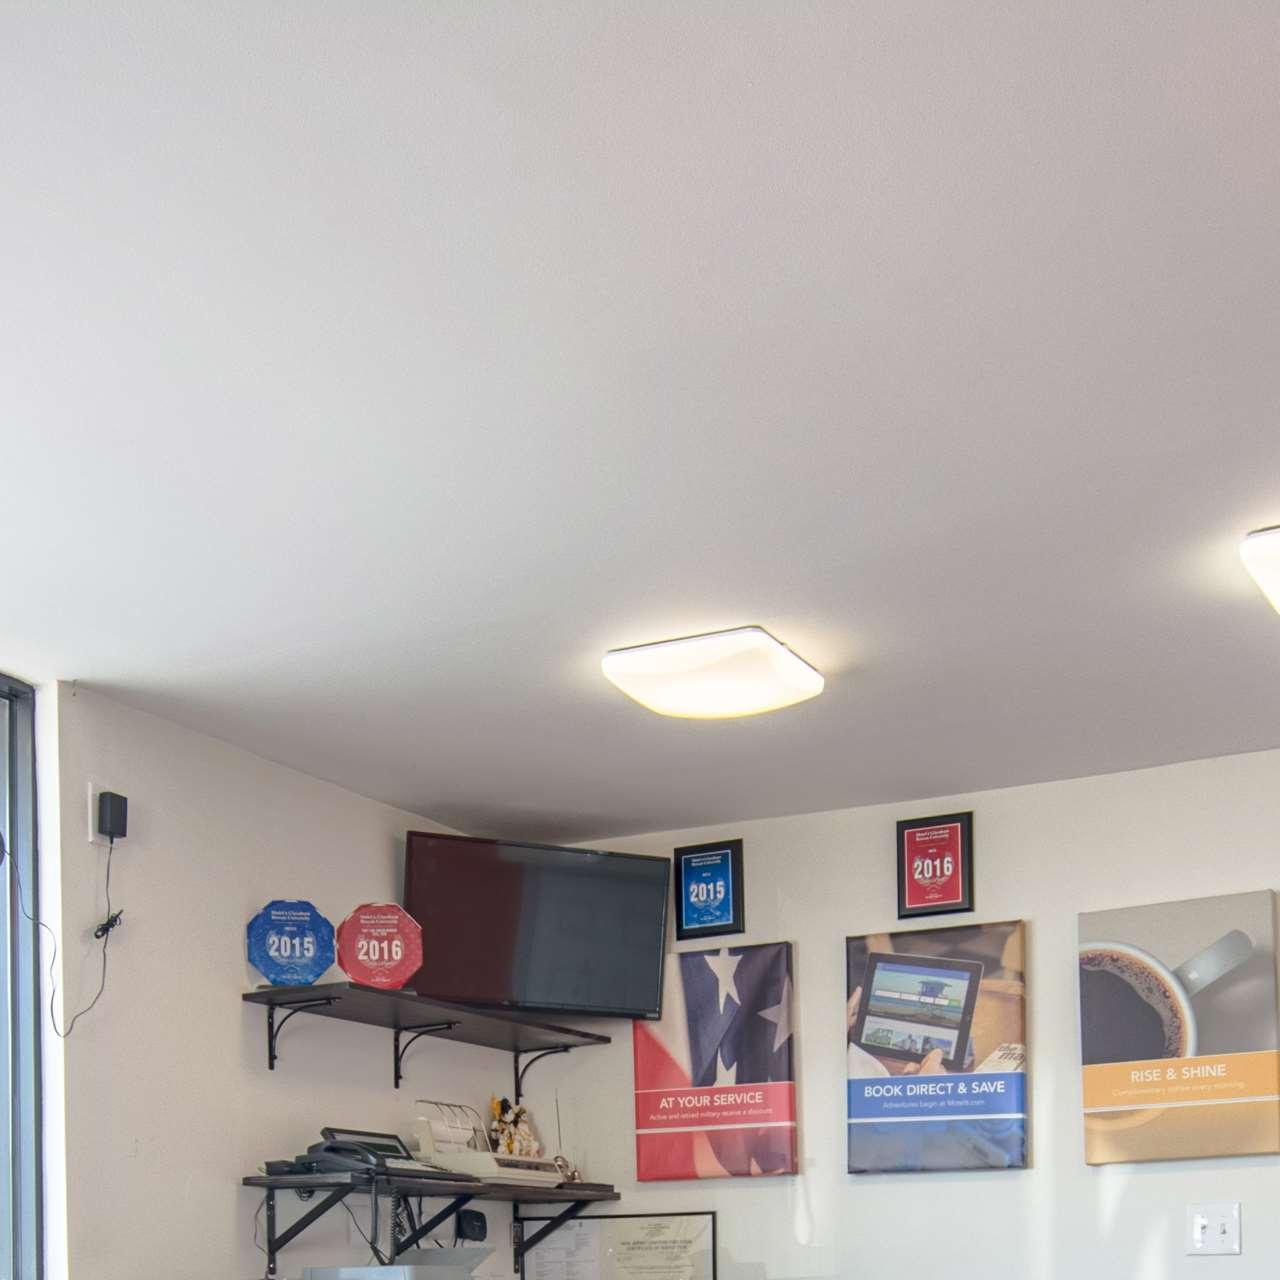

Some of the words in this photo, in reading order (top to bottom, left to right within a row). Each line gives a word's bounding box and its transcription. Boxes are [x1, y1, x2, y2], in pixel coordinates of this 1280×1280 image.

[914, 857, 952, 879] 2016
[690, 880, 725, 902] 2015
[269, 937, 314, 957] 2015
[358, 940, 402, 960] 2016
[1131, 1069, 1161, 1082] RISE
[1166, 1068, 1177, 1080] &
[1182, 1064, 1226, 1079] SHINE
[864, 1085, 902, 1097] BOOK
[907, 1083, 954, 1096] DIRECT
[957, 1082, 967, 1094] &
[971, 1081, 1005, 1093] SAVE
[660, 1097, 675, 1109] AT
[678, 1096, 710, 1108] YOUR
[713, 1092, 763, 1106] SERVICE
